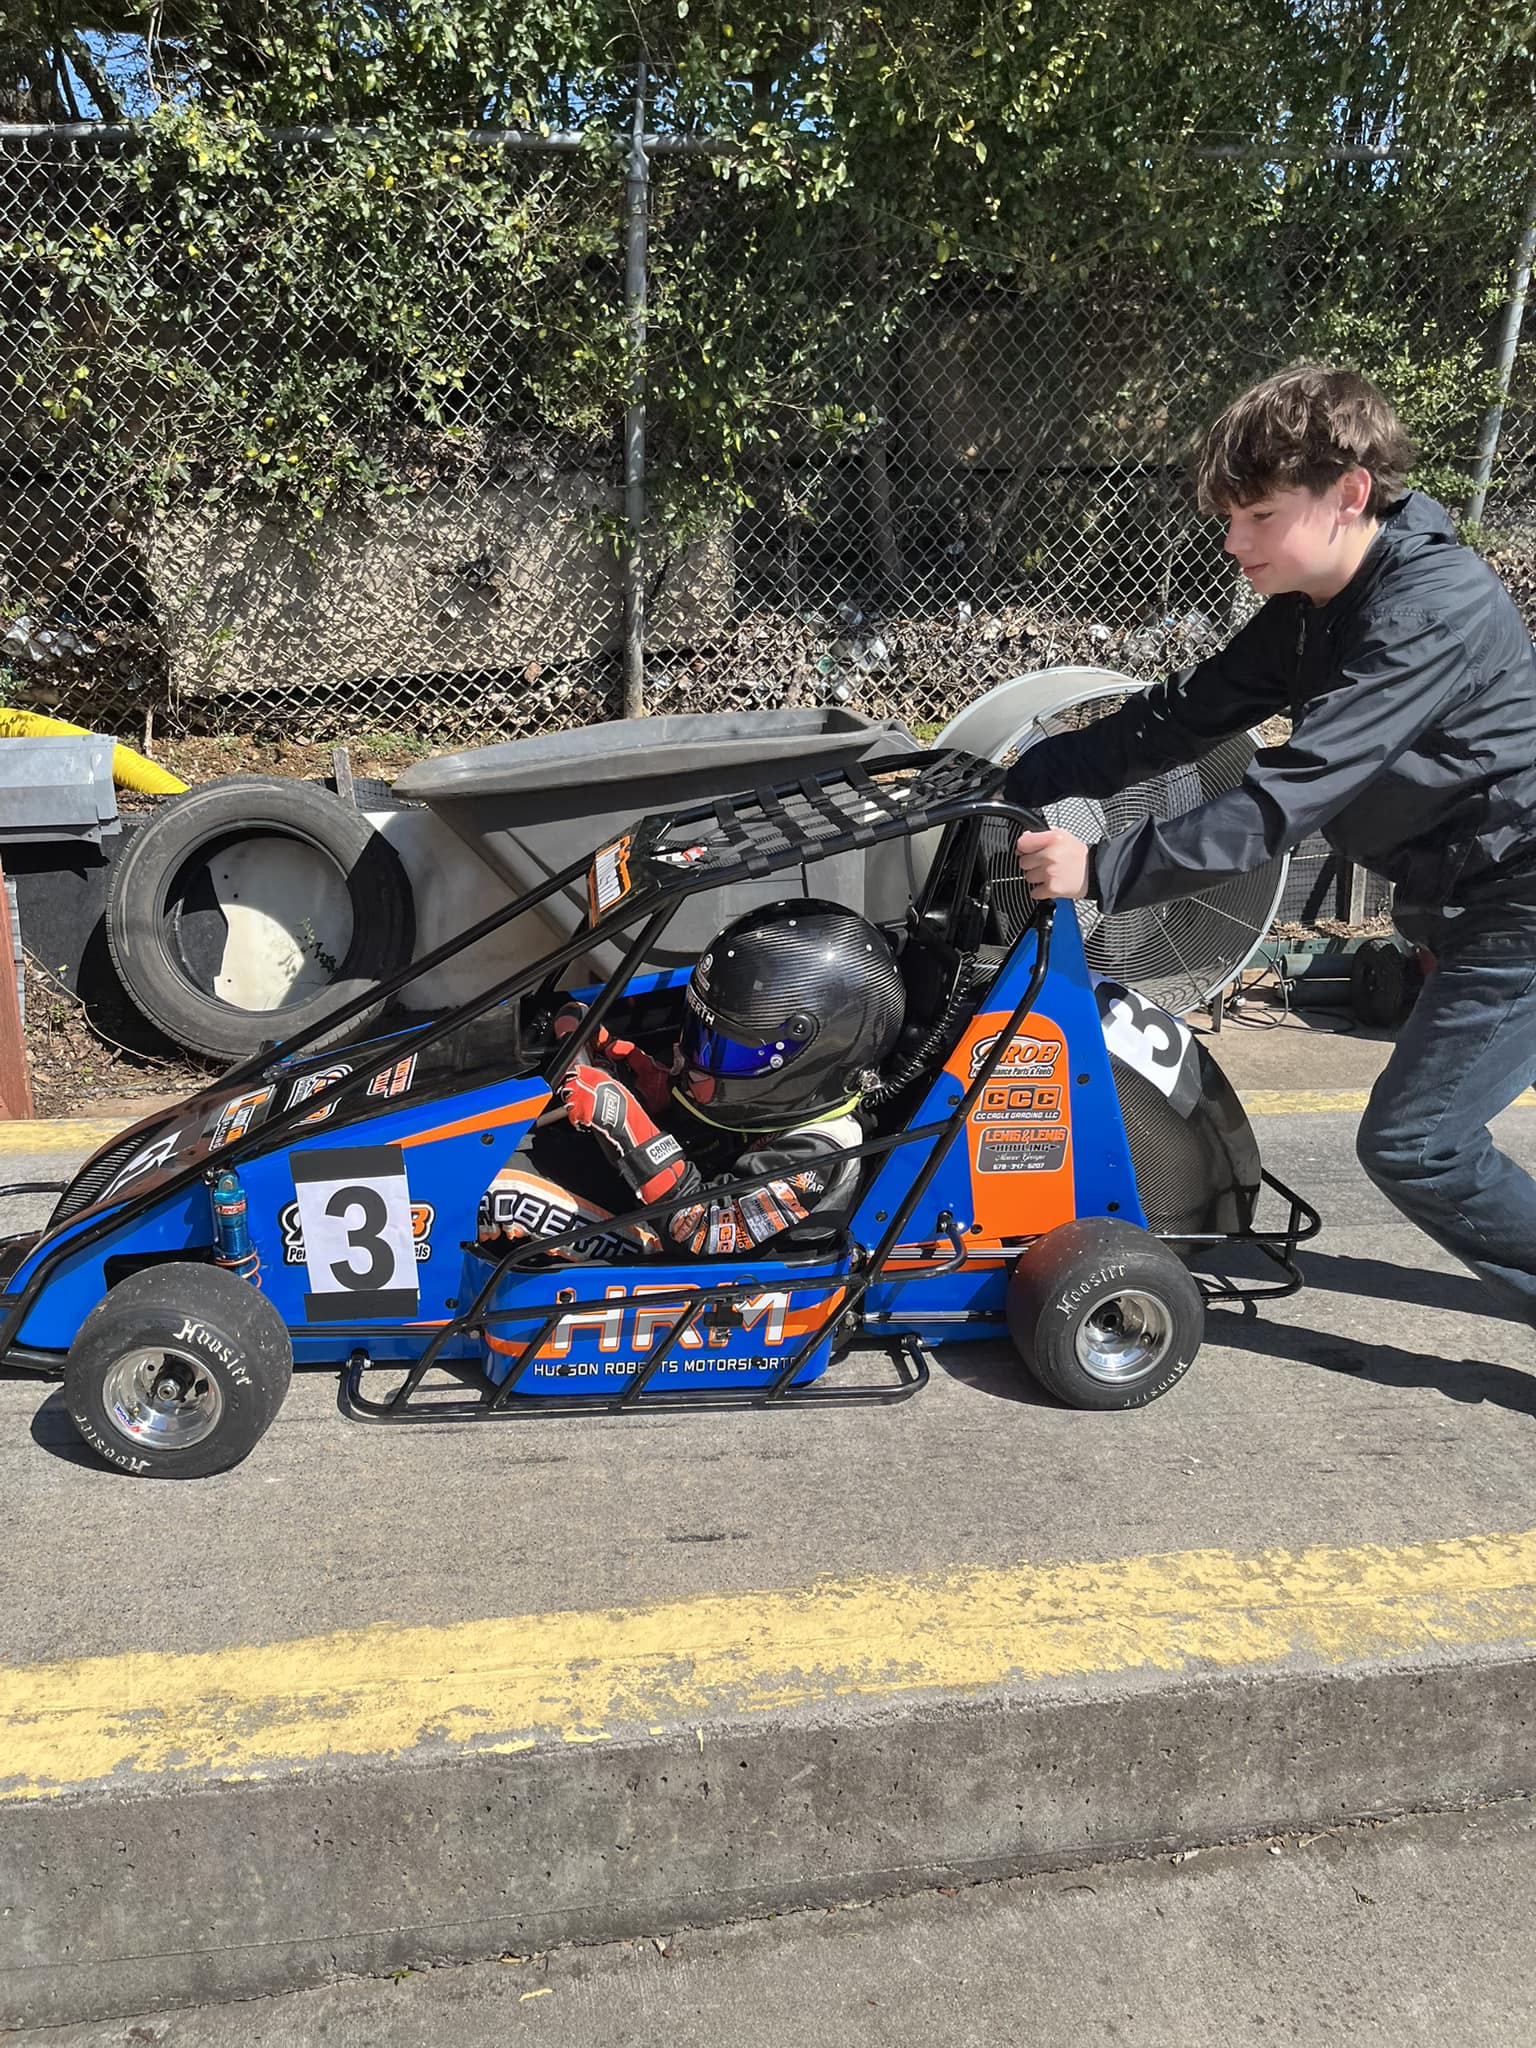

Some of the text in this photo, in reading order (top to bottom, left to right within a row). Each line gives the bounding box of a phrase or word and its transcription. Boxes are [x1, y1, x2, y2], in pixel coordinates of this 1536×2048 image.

[1095, 982, 1182, 1068] 3
[988, 1090, 1055, 1108] CCC
[1044, 1111, 1059, 1119] LLC
[996, 1143, 1050, 1153] HAULING
[325, 1186, 395, 1290] 3
[551, 1283, 793, 1352] HRM
[1056, 1264, 1126, 1320] Hoosier
[172, 1319, 253, 1386] Hoosier
[605, 1361, 678, 1375] ROBETS
[75, 1415, 152, 1473] Hoosier
